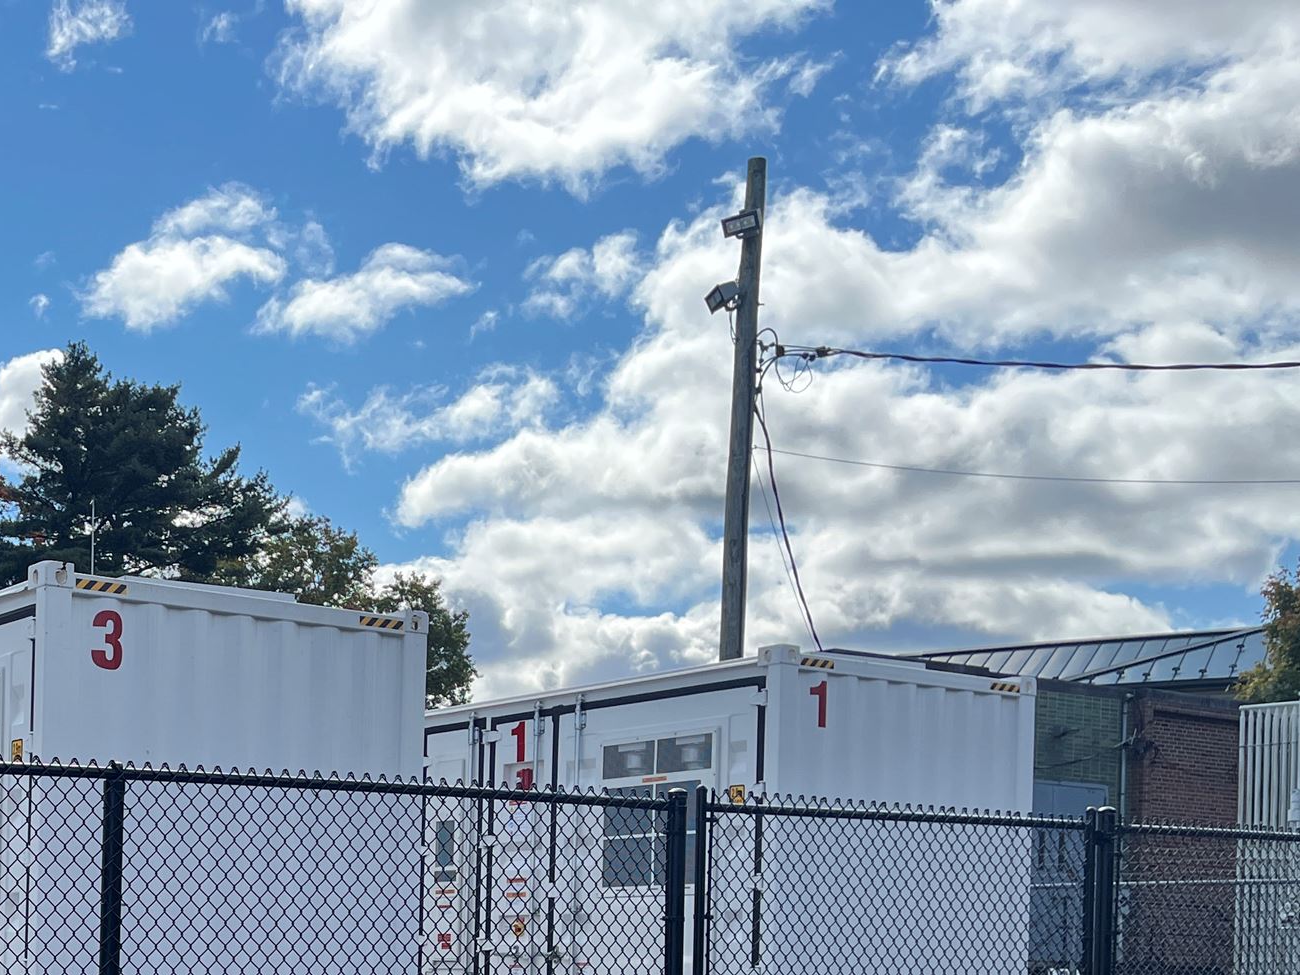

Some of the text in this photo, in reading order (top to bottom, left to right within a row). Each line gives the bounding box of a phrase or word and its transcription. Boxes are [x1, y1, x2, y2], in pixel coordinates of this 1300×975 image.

[91, 609, 123, 670] 3
[810, 680, 827, 728] 1
[511, 720, 525, 762] 1
